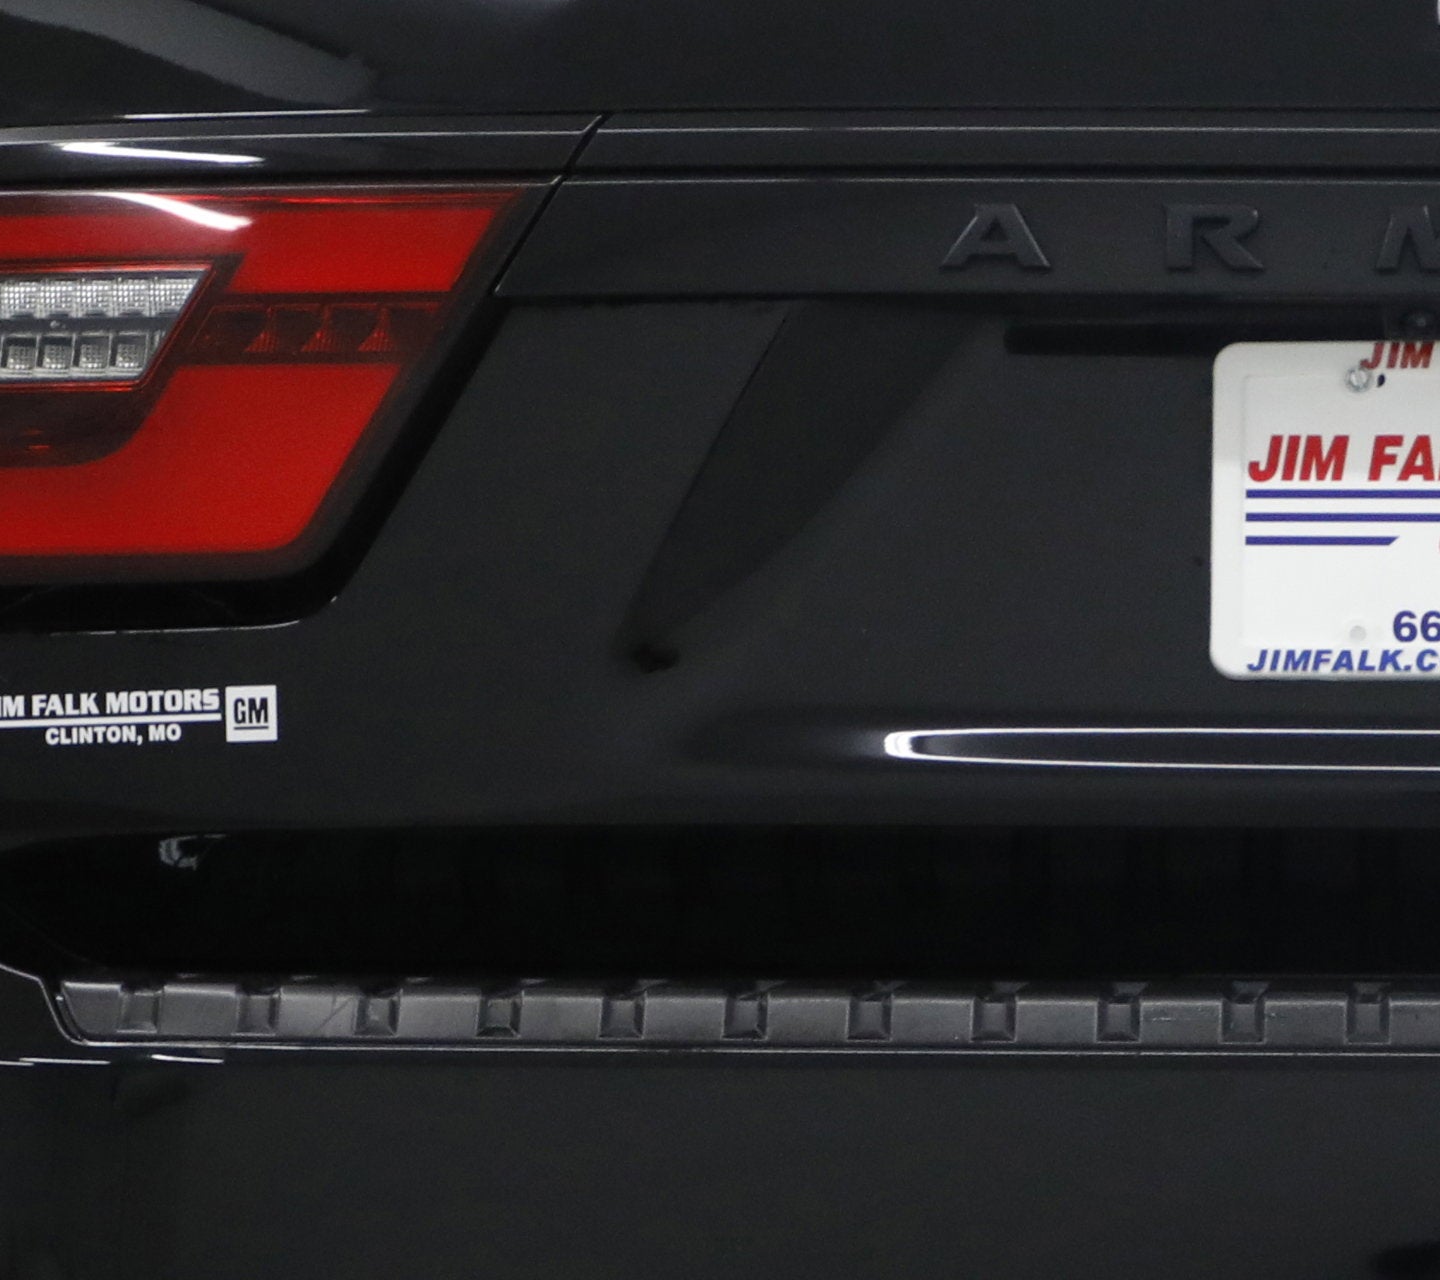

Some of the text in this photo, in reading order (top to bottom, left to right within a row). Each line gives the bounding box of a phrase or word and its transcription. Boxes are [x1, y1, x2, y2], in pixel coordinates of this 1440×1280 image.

[1360, 341, 1434, 369] JIM
[1248, 435, 1348, 482] JIM
[31, 692, 100, 717] FALK
[105, 688, 220, 715] MOTORS
[233, 697, 269, 725] GM
[45, 723, 182, 746] CLINTON, MO
